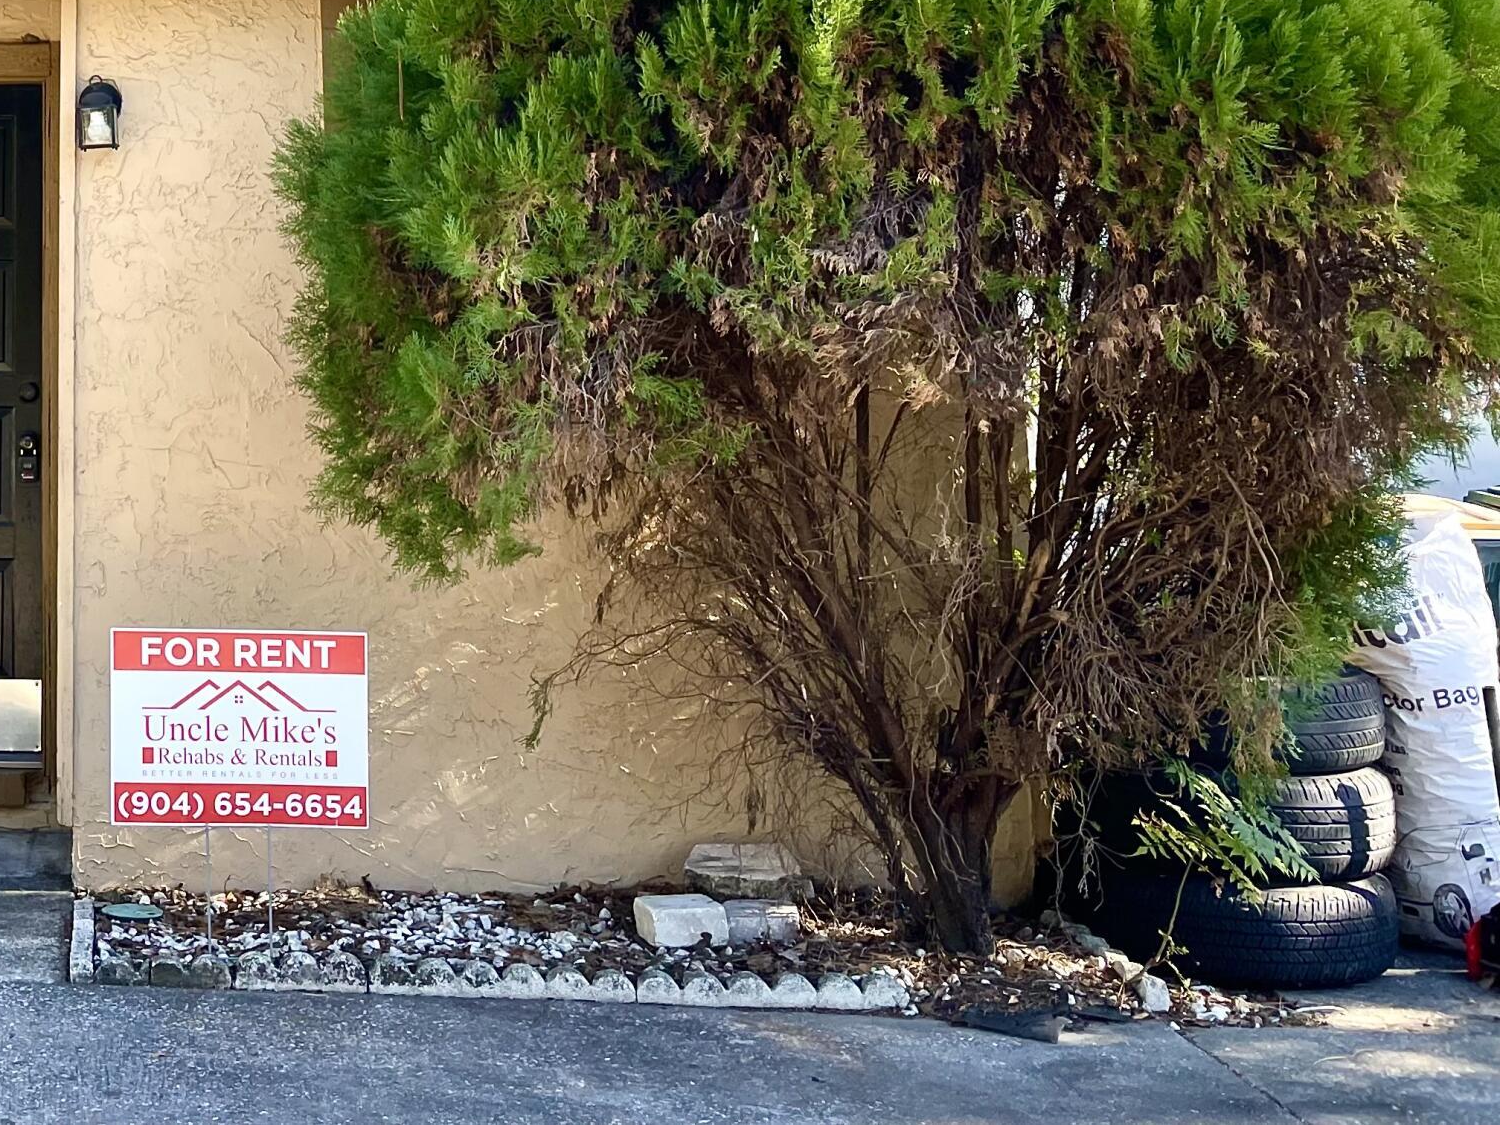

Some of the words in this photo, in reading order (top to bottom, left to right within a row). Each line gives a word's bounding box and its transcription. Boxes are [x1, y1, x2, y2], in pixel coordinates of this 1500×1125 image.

[140, 636, 220, 667] FOR
[233, 638, 337, 669] RENT
[1432, 686, 1480, 709] Bag
[143, 714, 229, 743] Uncle
[239, 716, 337, 745] Mike's
[158, 747, 225, 766] Rehabs
[230, 749, 247, 765] &
[254, 749, 323, 768] Rentals
[142, 770, 193, 778] BETTER
[202, 770, 263, 779] RENTALS
[271, 771, 297, 779] FOR
[306, 772, 339, 780] LESS
[117, 790, 205, 820] (904)
[214, 792, 364, 820] 654-6654
